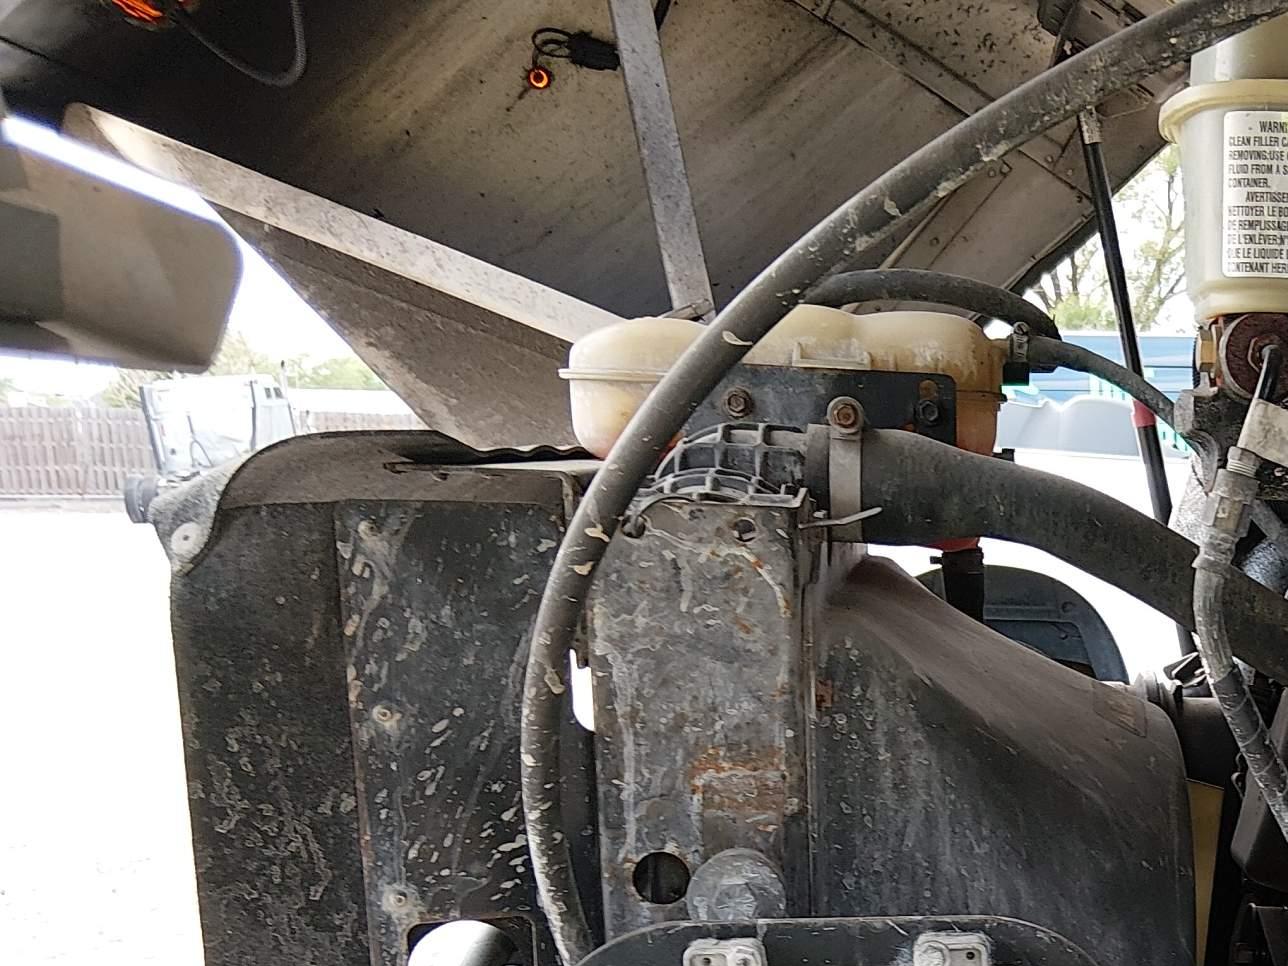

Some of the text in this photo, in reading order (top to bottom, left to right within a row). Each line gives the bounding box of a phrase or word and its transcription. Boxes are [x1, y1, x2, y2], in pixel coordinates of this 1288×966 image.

[1229, 136, 1251, 147] CLEAN
[1253, 136, 1280, 147] FILLER
[1228, 164, 1249, 175] FLUID
[1251, 164, 1273, 175] FROM
[1275, 164, 1281, 175] A
[1228, 178, 1271, 188] CONTAINER.
[1228, 206, 1265, 217] NETTOYER
[1267, 206, 1276, 217] LE
[1228, 220, 1237, 230] DE
[1242, 248, 1252, 259] LE
[1253, 248, 1283, 260] LIQUIDE
